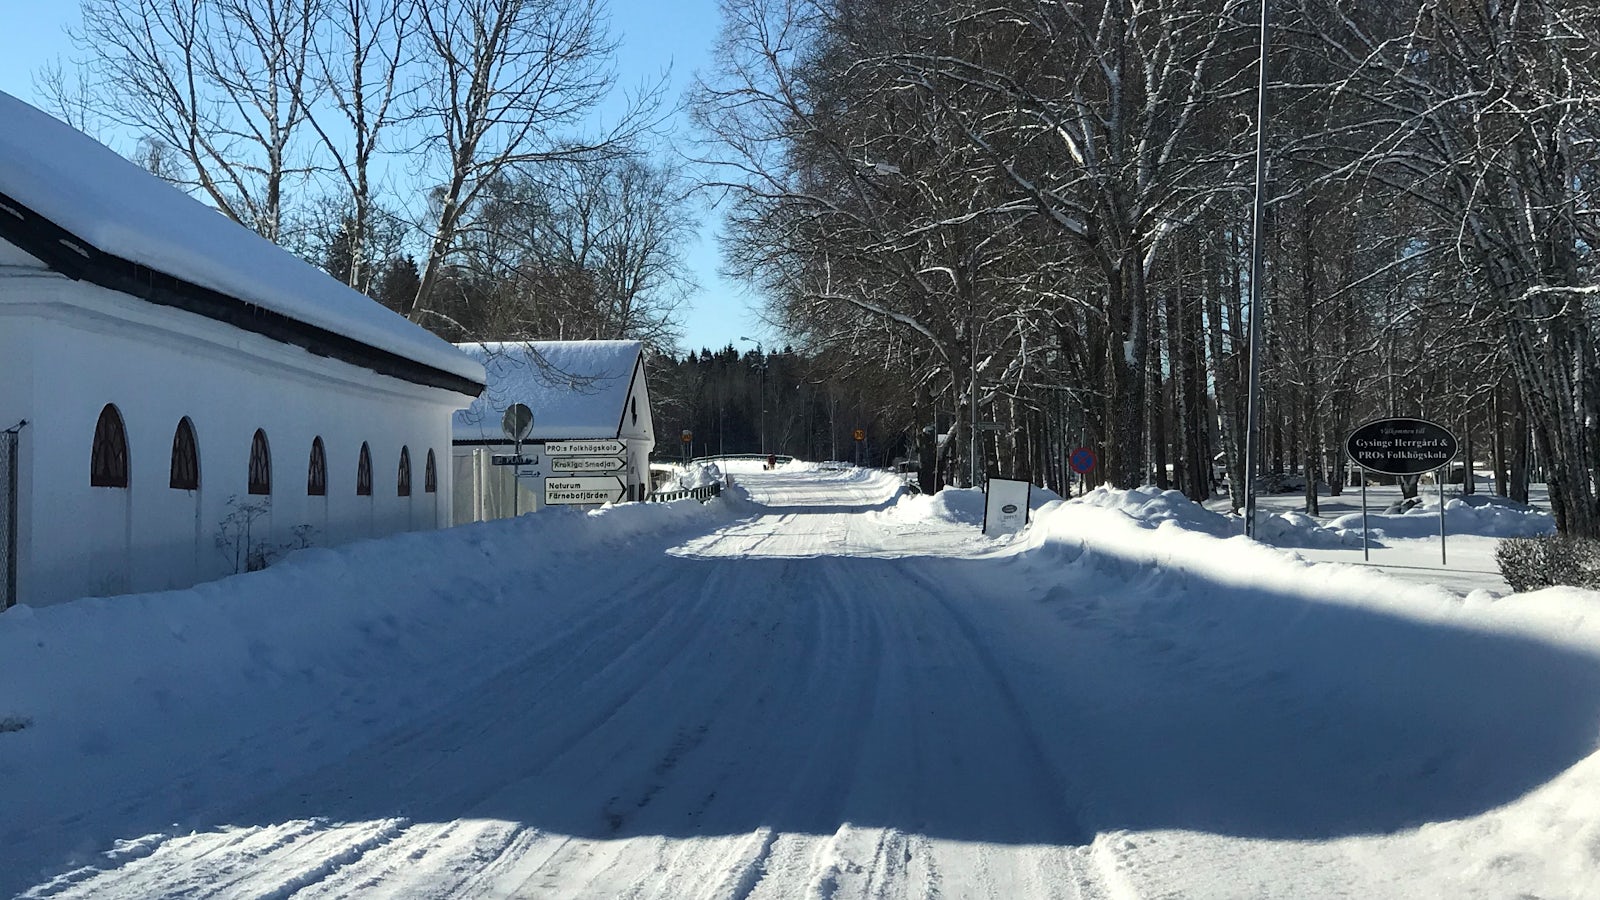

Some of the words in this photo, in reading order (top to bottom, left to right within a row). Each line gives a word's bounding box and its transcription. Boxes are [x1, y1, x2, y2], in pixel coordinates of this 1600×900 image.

[1356, 439, 1393, 448] Gysinge
[1395, 439, 1438, 448] Herrgård
[1440, 439, 1448, 447] &
[569, 444, 617, 452] Folkhögskola
[1359, 451, 1385, 459] PROs
[1387, 451, 1447, 460] Folkhögskola
[548, 492, 609, 500] Färnebofjärden
